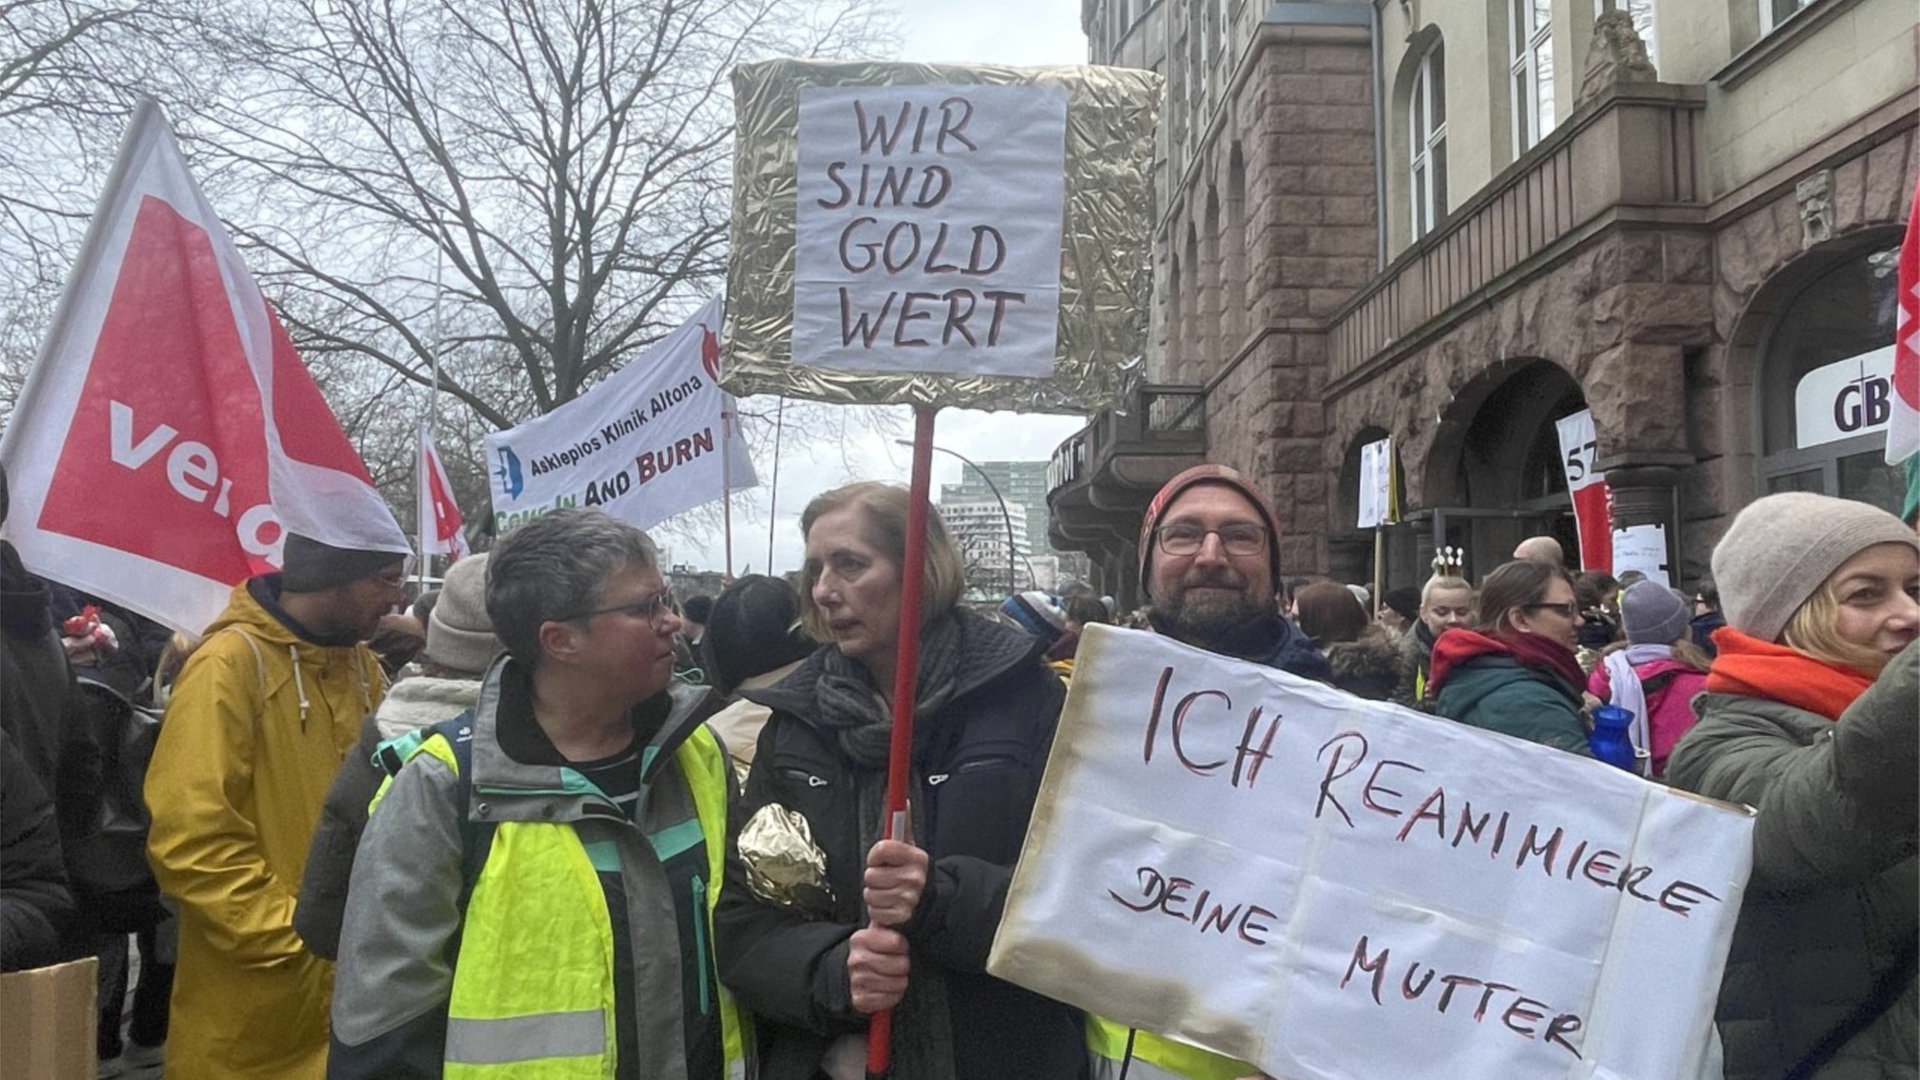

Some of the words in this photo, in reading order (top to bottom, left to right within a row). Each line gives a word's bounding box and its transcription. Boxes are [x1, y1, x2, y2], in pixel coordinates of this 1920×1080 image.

[854, 97, 977, 156] WIR
[817, 162, 952, 209] SIND
[839, 217, 1006, 275] GOLD
[839, 287, 1026, 348] WERT
[530, 436, 601, 477] Asklepios
[601, 409, 648, 445] Klinik
[650, 375, 702, 418] Altona
[1834, 375, 1895, 432] GB
[584, 471, 630, 507] AND
[636, 427, 714, 485] BURN
[1144, 666, 1283, 788] ICH
[1314, 731, 1722, 917] REANIMIERE
[1108, 866, 1278, 946] DEINE
[1340, 936, 1582, 1060] MUTTER
